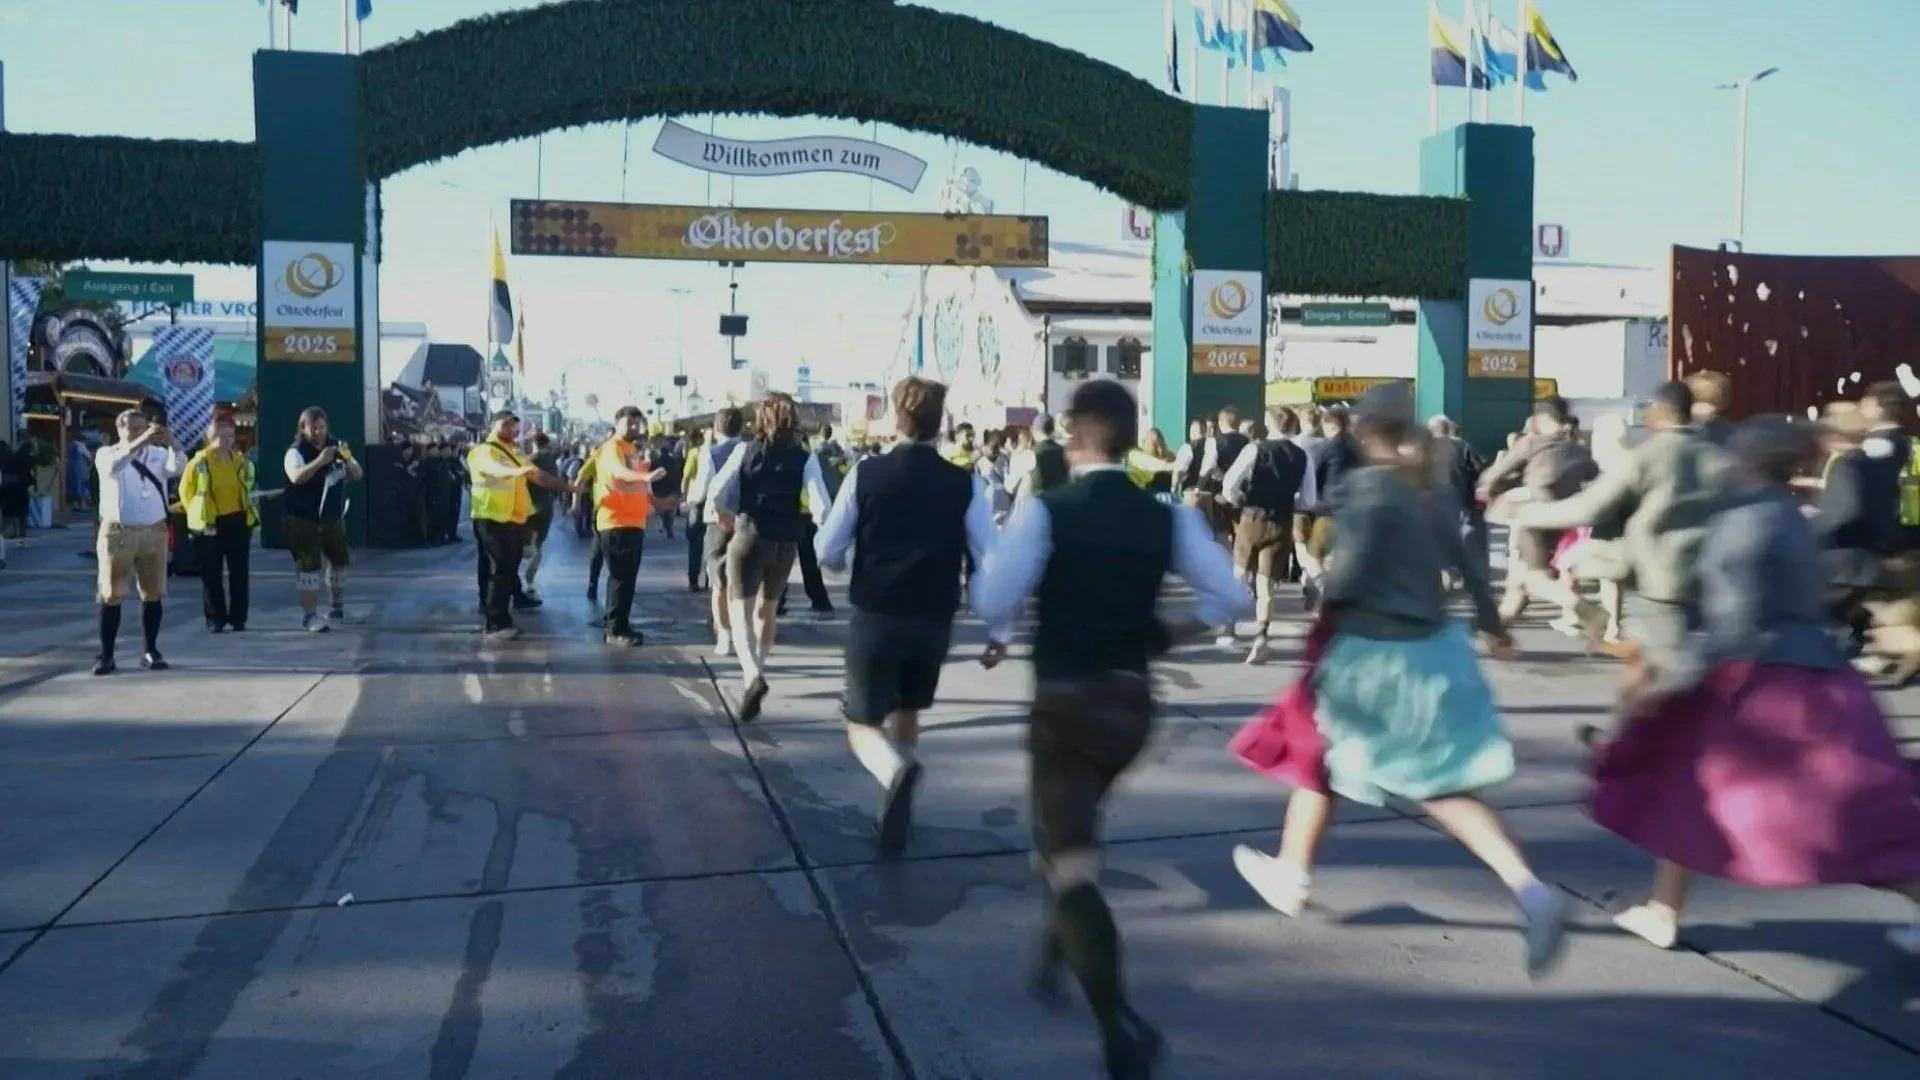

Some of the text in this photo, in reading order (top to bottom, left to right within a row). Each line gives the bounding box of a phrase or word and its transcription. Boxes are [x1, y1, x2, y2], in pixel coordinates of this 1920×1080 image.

[702, 141, 881, 170] Willkommen zum
[683, 212, 896, 258] Oktoberfest
[83, 280, 140, 295] Ausgang
[150, 281, 174, 293] Exit
[276, 304, 343, 318] Oktoberfest
[1202, 324, 1252, 336] Oktoberfest
[284, 335, 336, 353] 2025
[1207, 351, 1247, 368] 2025
[1481, 355, 1516, 372] 2025
